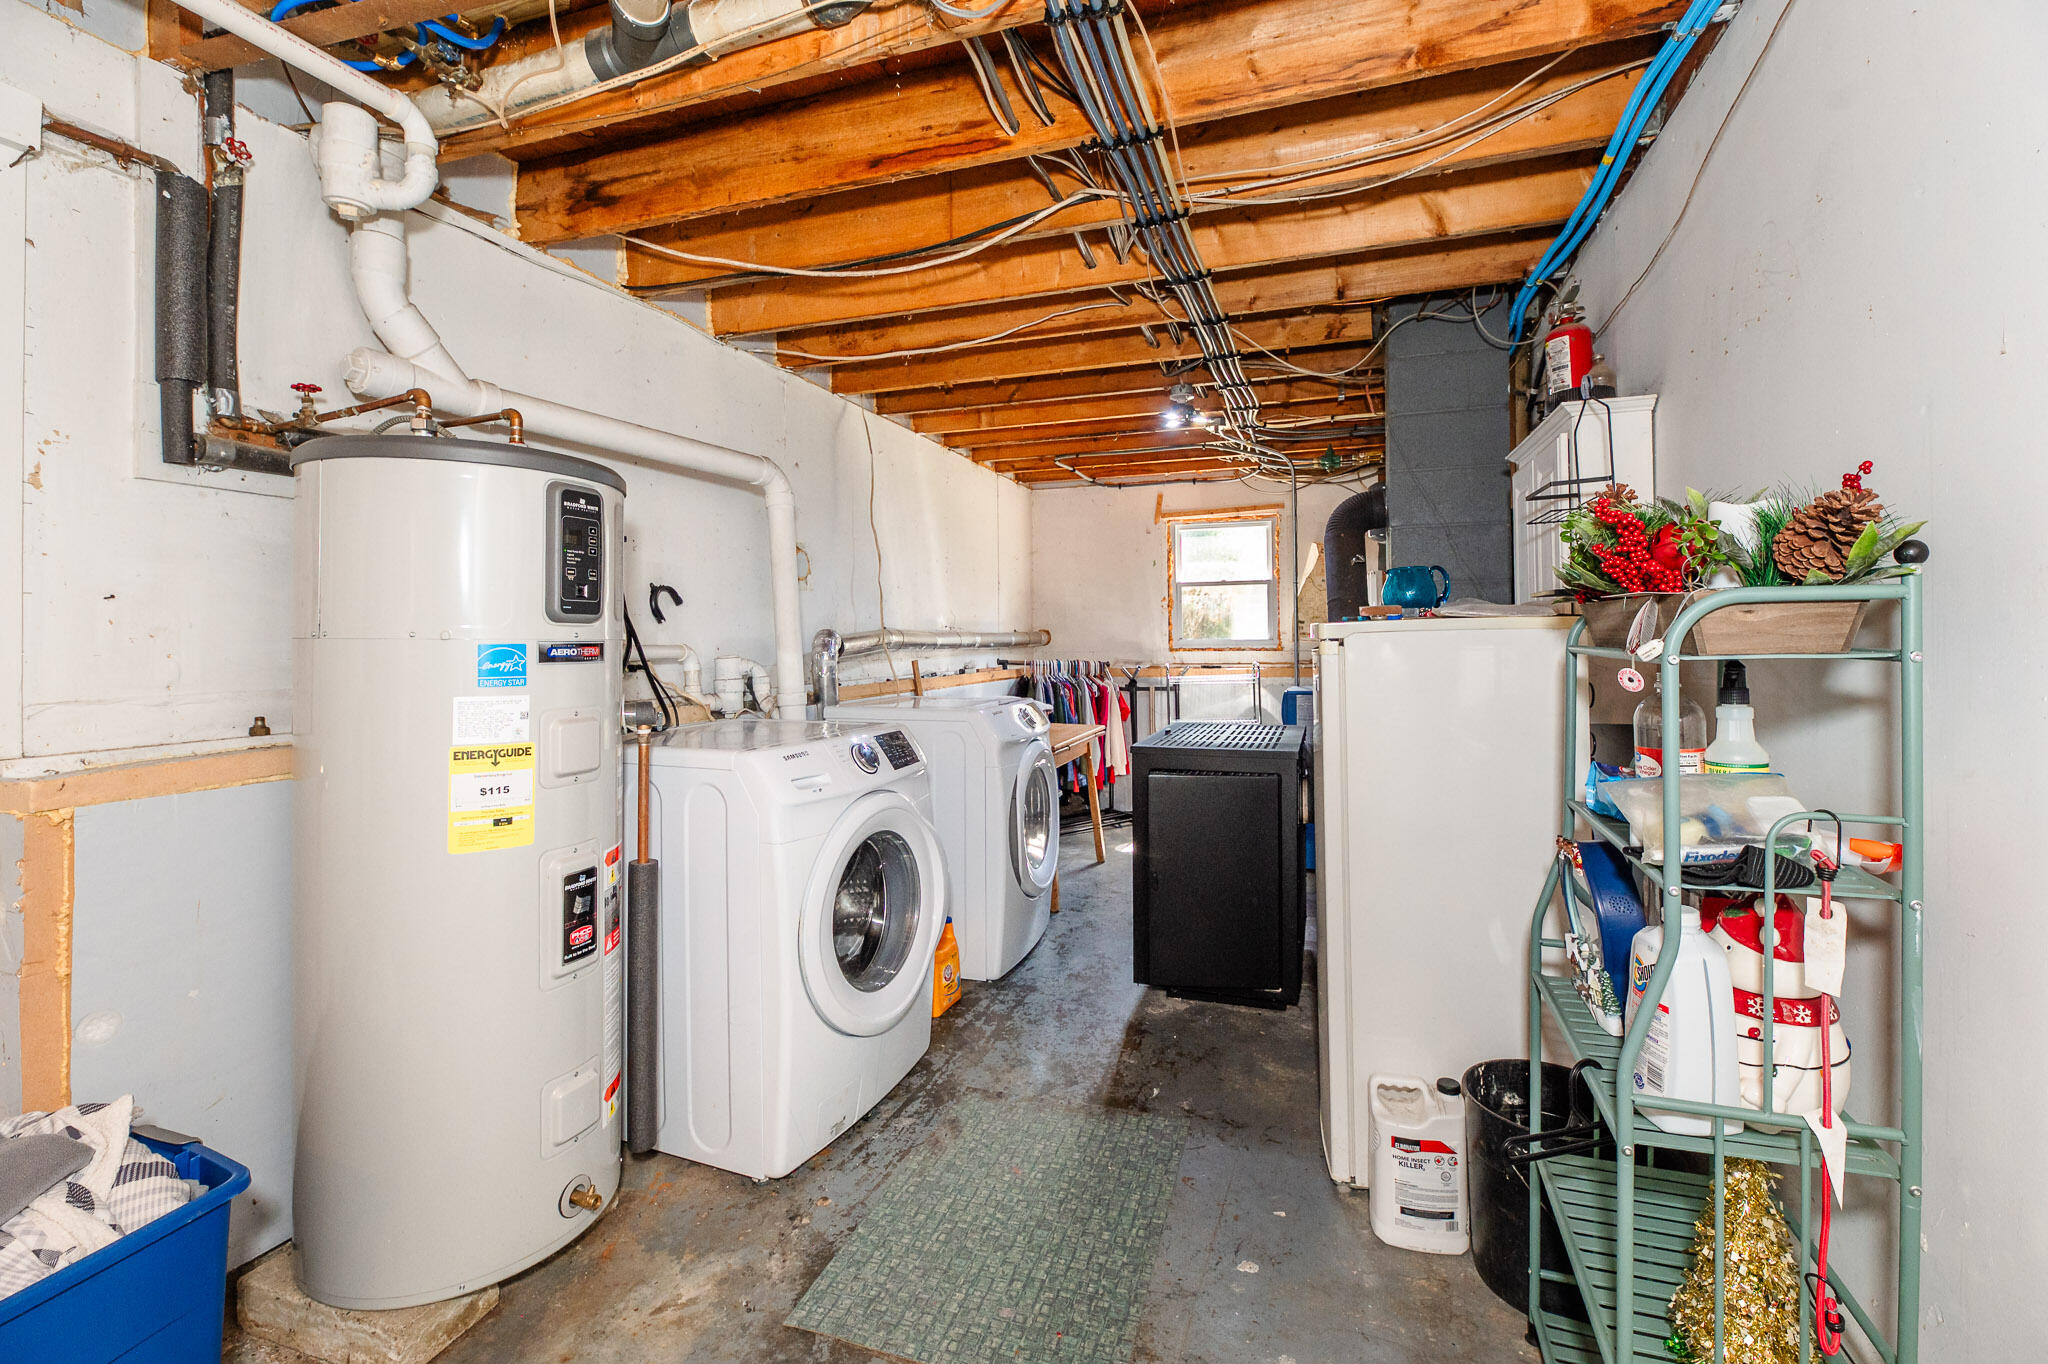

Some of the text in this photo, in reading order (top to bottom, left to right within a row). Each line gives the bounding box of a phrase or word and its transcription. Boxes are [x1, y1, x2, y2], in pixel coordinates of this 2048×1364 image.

[453, 746, 532, 761] ENERGYGUIDE
[480, 785, 510, 796] $115
[1392, 1154, 1409, 1162] HOME
